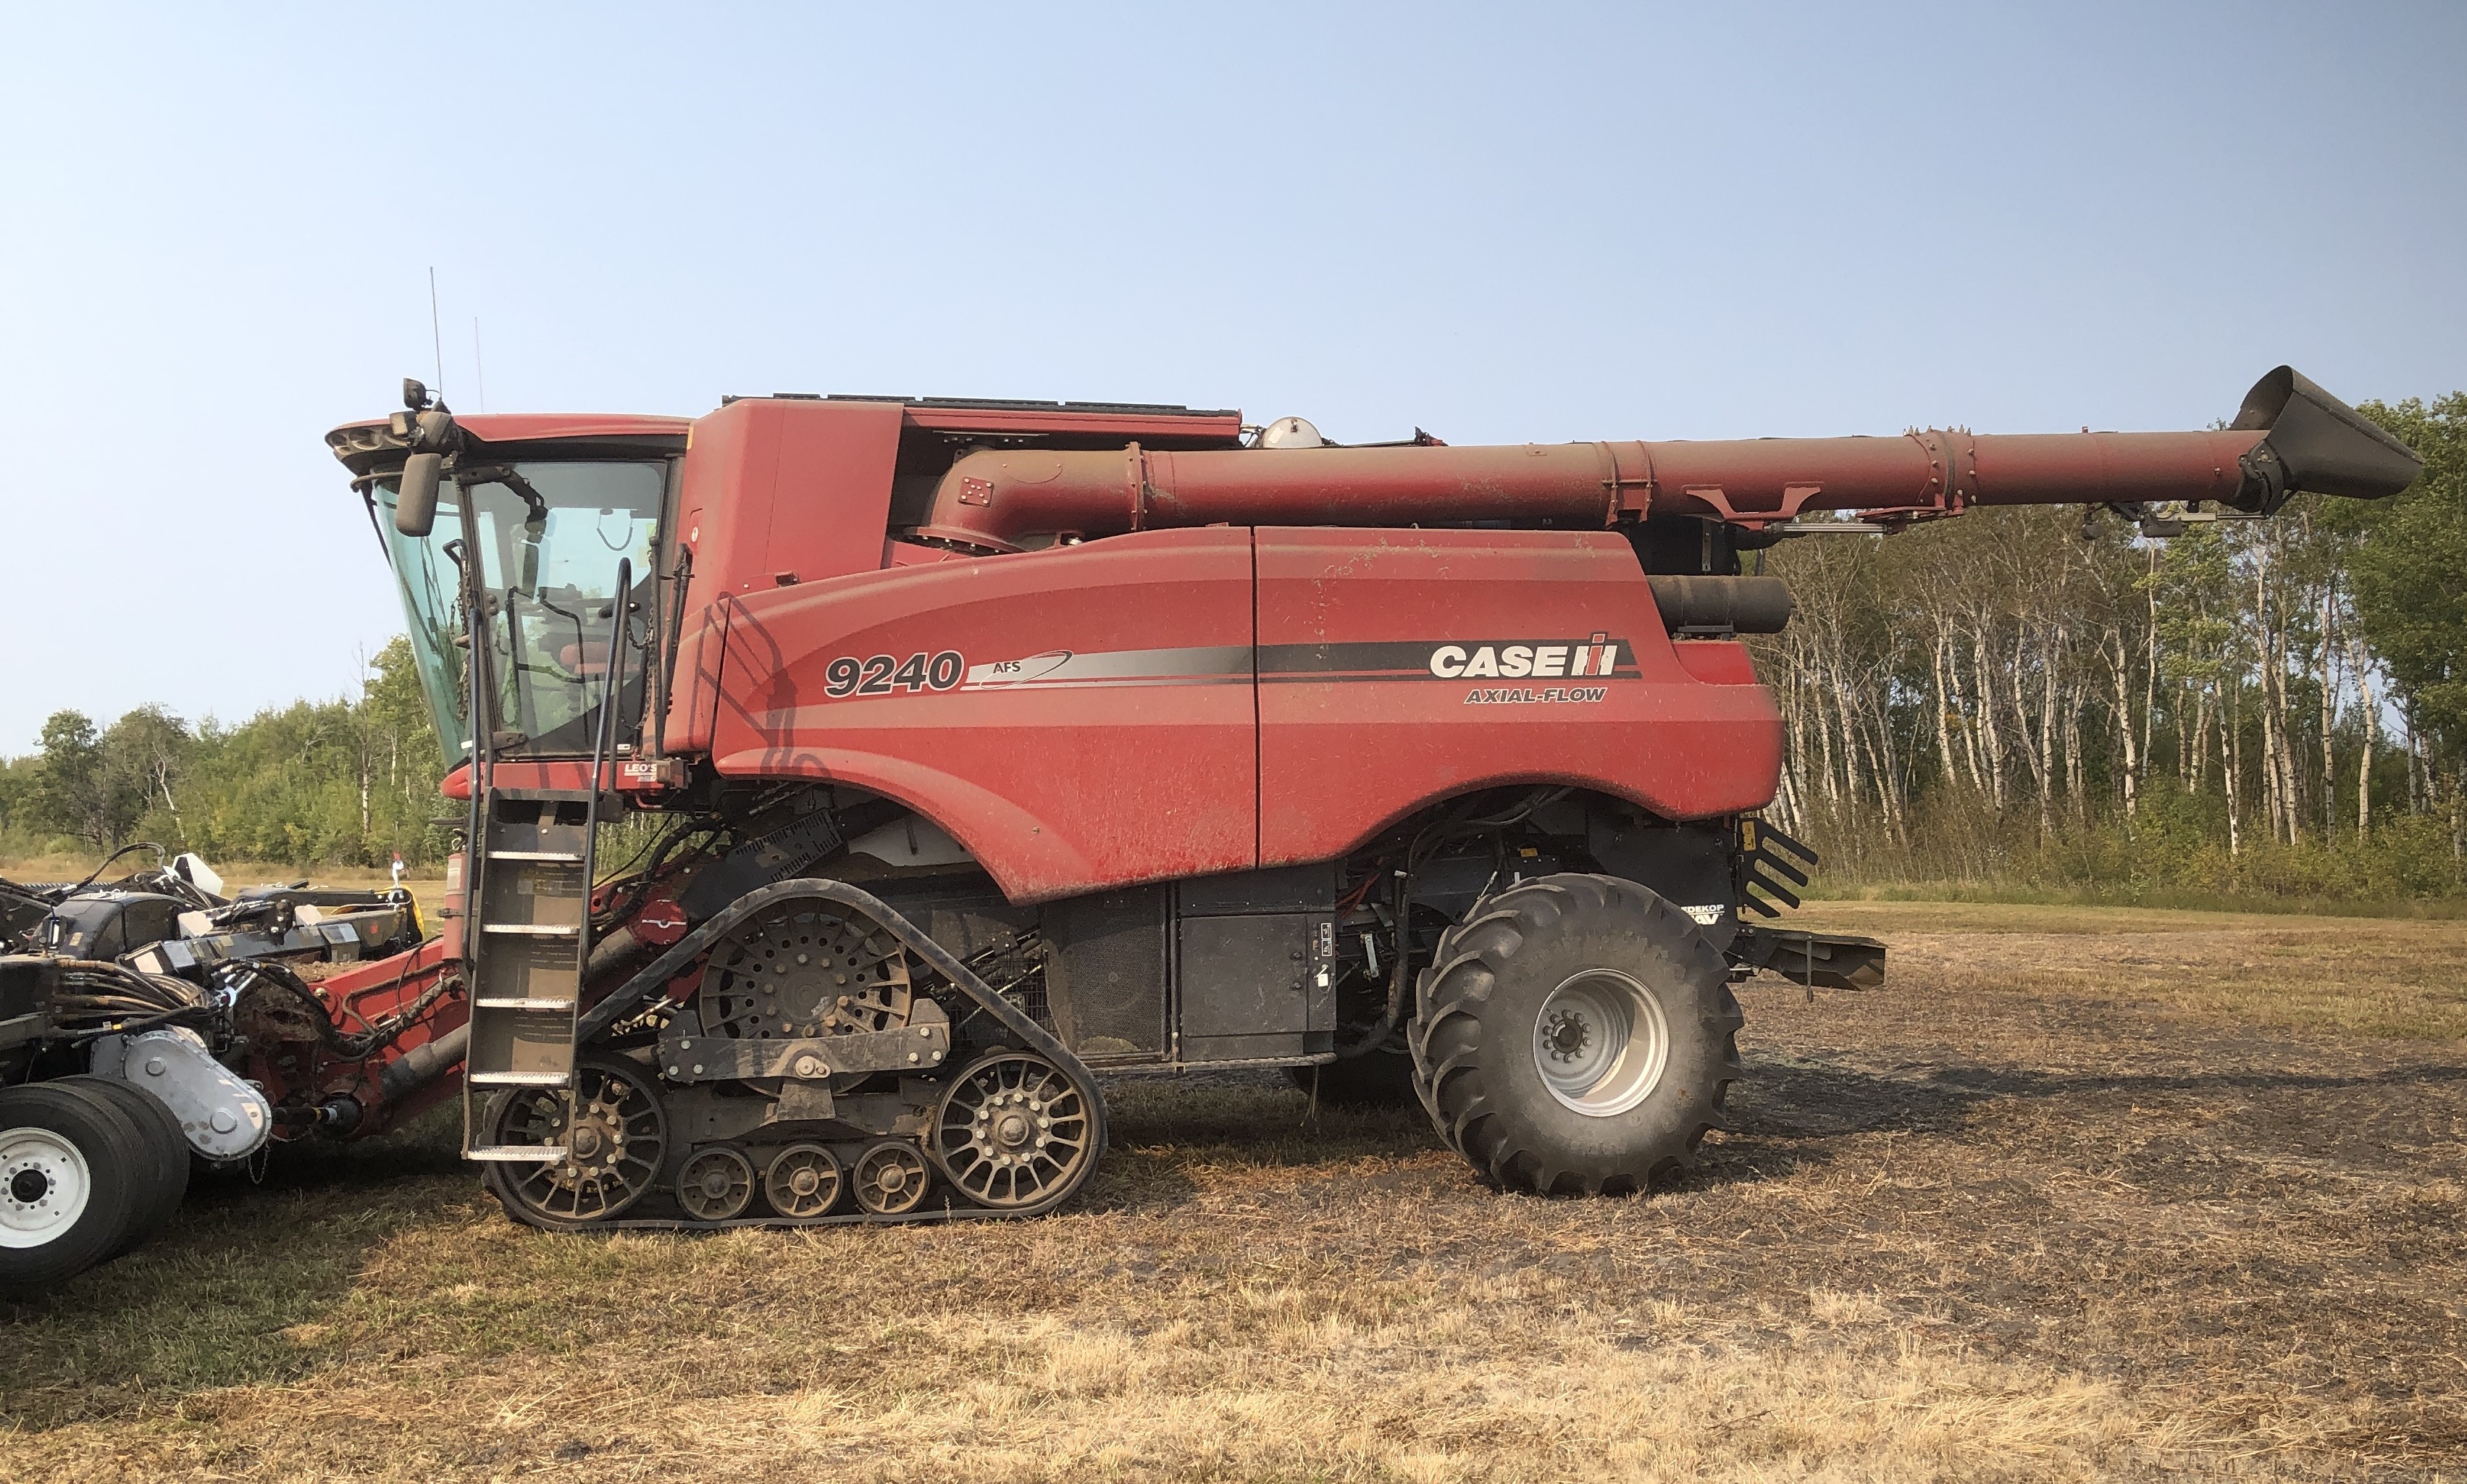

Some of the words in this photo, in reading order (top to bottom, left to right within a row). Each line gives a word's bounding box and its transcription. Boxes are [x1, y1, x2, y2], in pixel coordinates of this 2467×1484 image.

[993, 661, 1021, 674] AFS
[1430, 645, 1569, 678] CASE
[824, 650, 965, 698] 9240
[1463, 687, 1609, 705] AXIAL-FLOW
[624, 763, 658, 773] LEO'S
